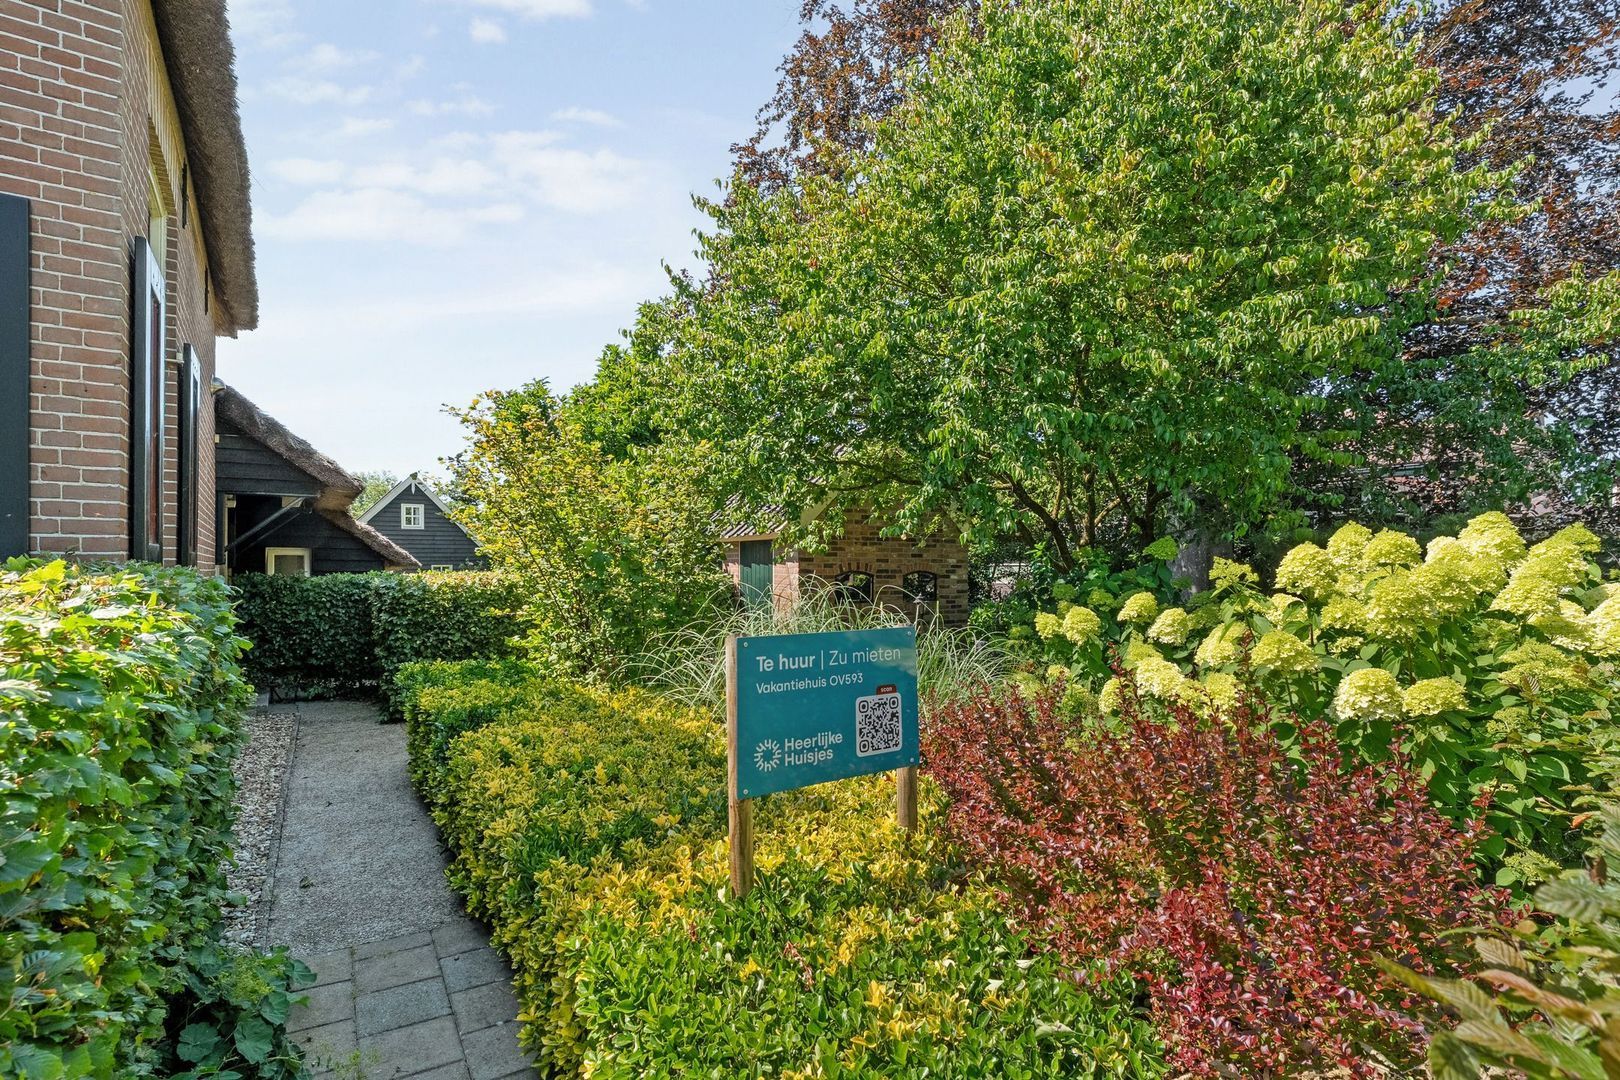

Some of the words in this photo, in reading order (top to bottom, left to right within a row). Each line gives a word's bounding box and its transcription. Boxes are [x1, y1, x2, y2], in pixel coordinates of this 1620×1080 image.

[756, 656, 774, 672] Te
[779, 653, 815, 670] huur
[829, 650, 847, 666] Zu
[852, 648, 900, 663] mieten
[756, 676, 826, 694] Vakantiehuis
[829, 672, 863, 686] OV593
[784, 731, 843, 751] Heerlijke
[784, 749, 834, 766] Huisjes
